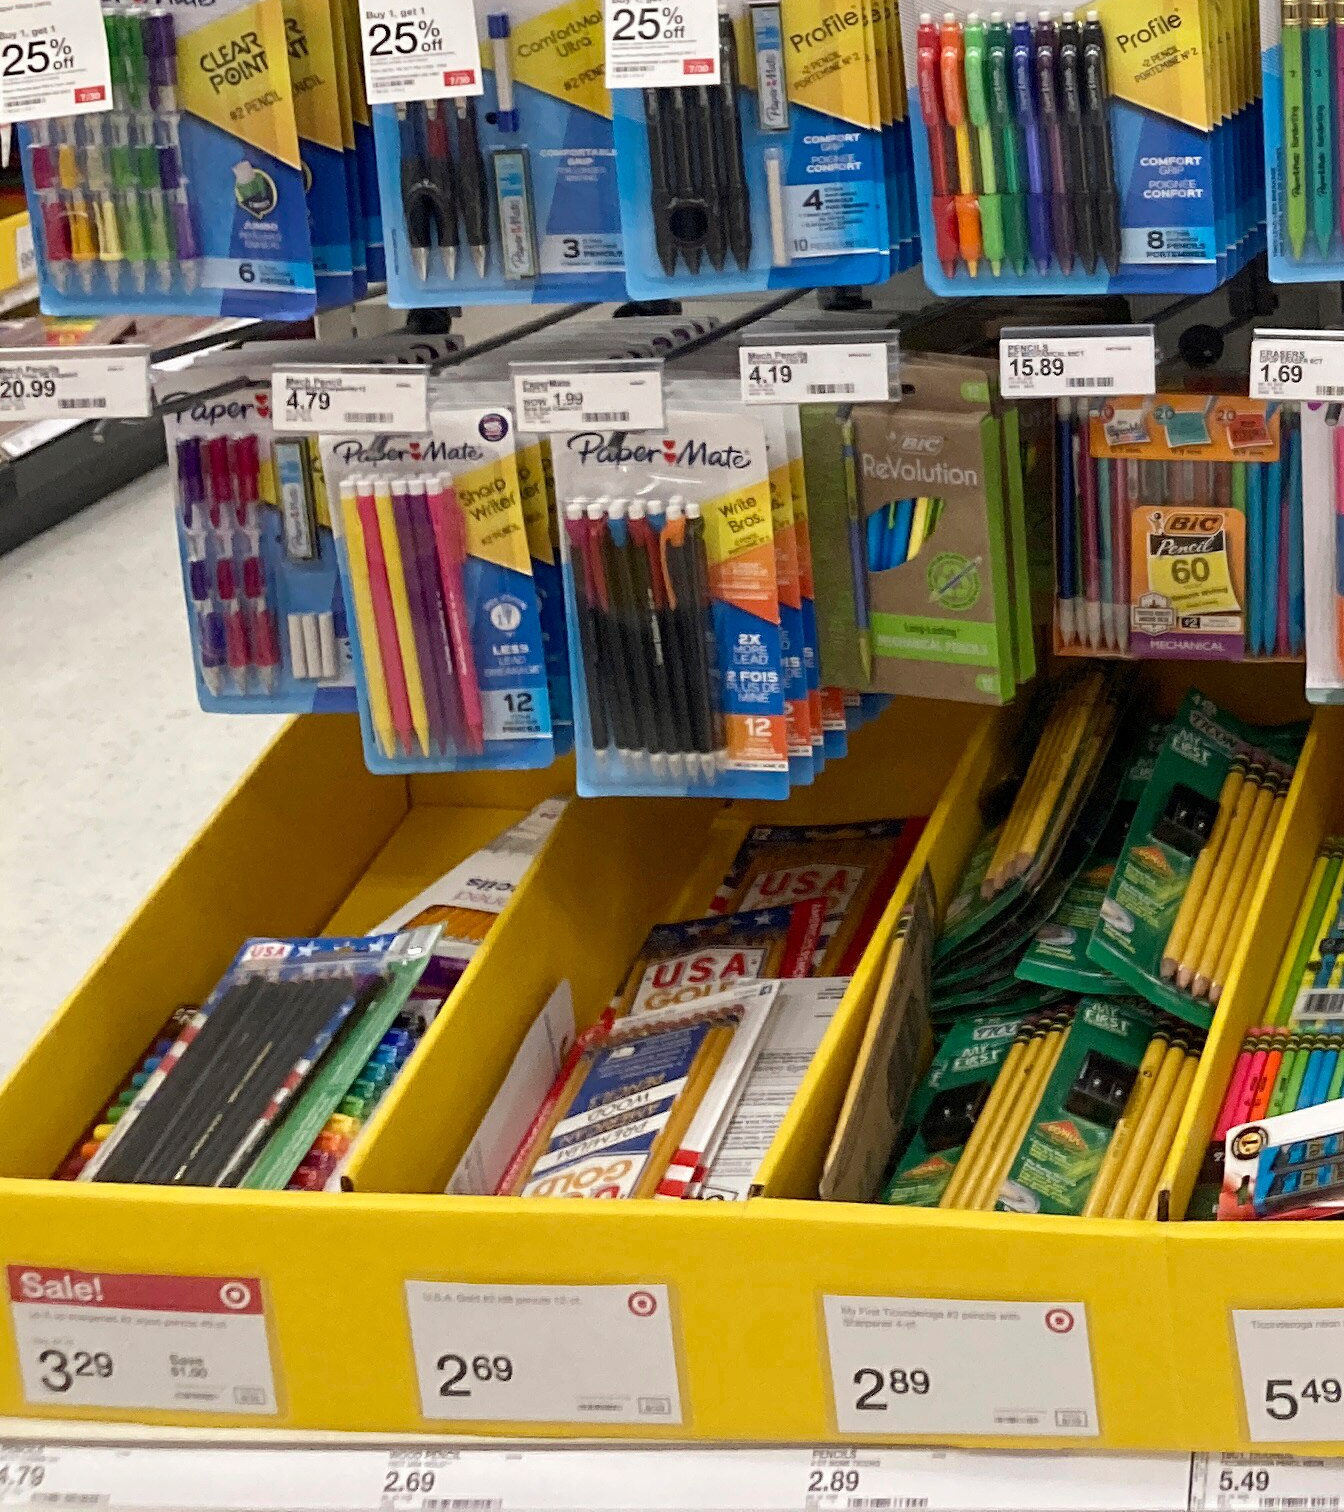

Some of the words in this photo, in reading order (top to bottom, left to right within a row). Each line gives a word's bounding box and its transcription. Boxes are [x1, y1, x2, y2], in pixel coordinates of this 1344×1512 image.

[368, 18, 441, 57] 25%
[612, 5, 684, 42] 25%
[662, 25, 686, 40] off
[789, 10, 860, 55] Profile
[1116, 13, 1183, 55] Profile
[2, 38, 72, 77] 25%
[200, 31, 264, 74] CLEAR
[421, 37, 444, 53] off
[53, 56, 75, 71] off
[208, 51, 270, 95] POINT
[1140, 155, 1202, 168] COMFORT
[748, 365, 793, 384] 4.19
[1008, 357, 1065, 378] 15.89
[1260, 364, 1303, 383] 1.69
[286, 390, 331, 412] 4.79
[333, 439, 409, 466] Paper
[423, 441, 484, 462] Mate
[574, 431, 661, 465] Paper
[674, 440, 751, 469] Mate
[861, 453, 979, 487] ReVolution
[1157, 534, 1215, 558] Pencil
[1171, 556, 1211, 585] 60
[503, 693, 534, 713] 12
[744, 718, 772, 738] 12
[651, 952, 747, 989] USA
[20, 1272, 104, 1302] Sale!
[436, 1354, 514, 1398] 269
[853, 1368, 931, 1411] 289
[1264, 1378, 1343, 1420] 549
[384, 1470, 435, 1493] 2.69
[808, 1470, 860, 1493] 2.89
[1219, 1469, 1270, 1493] 5.49
